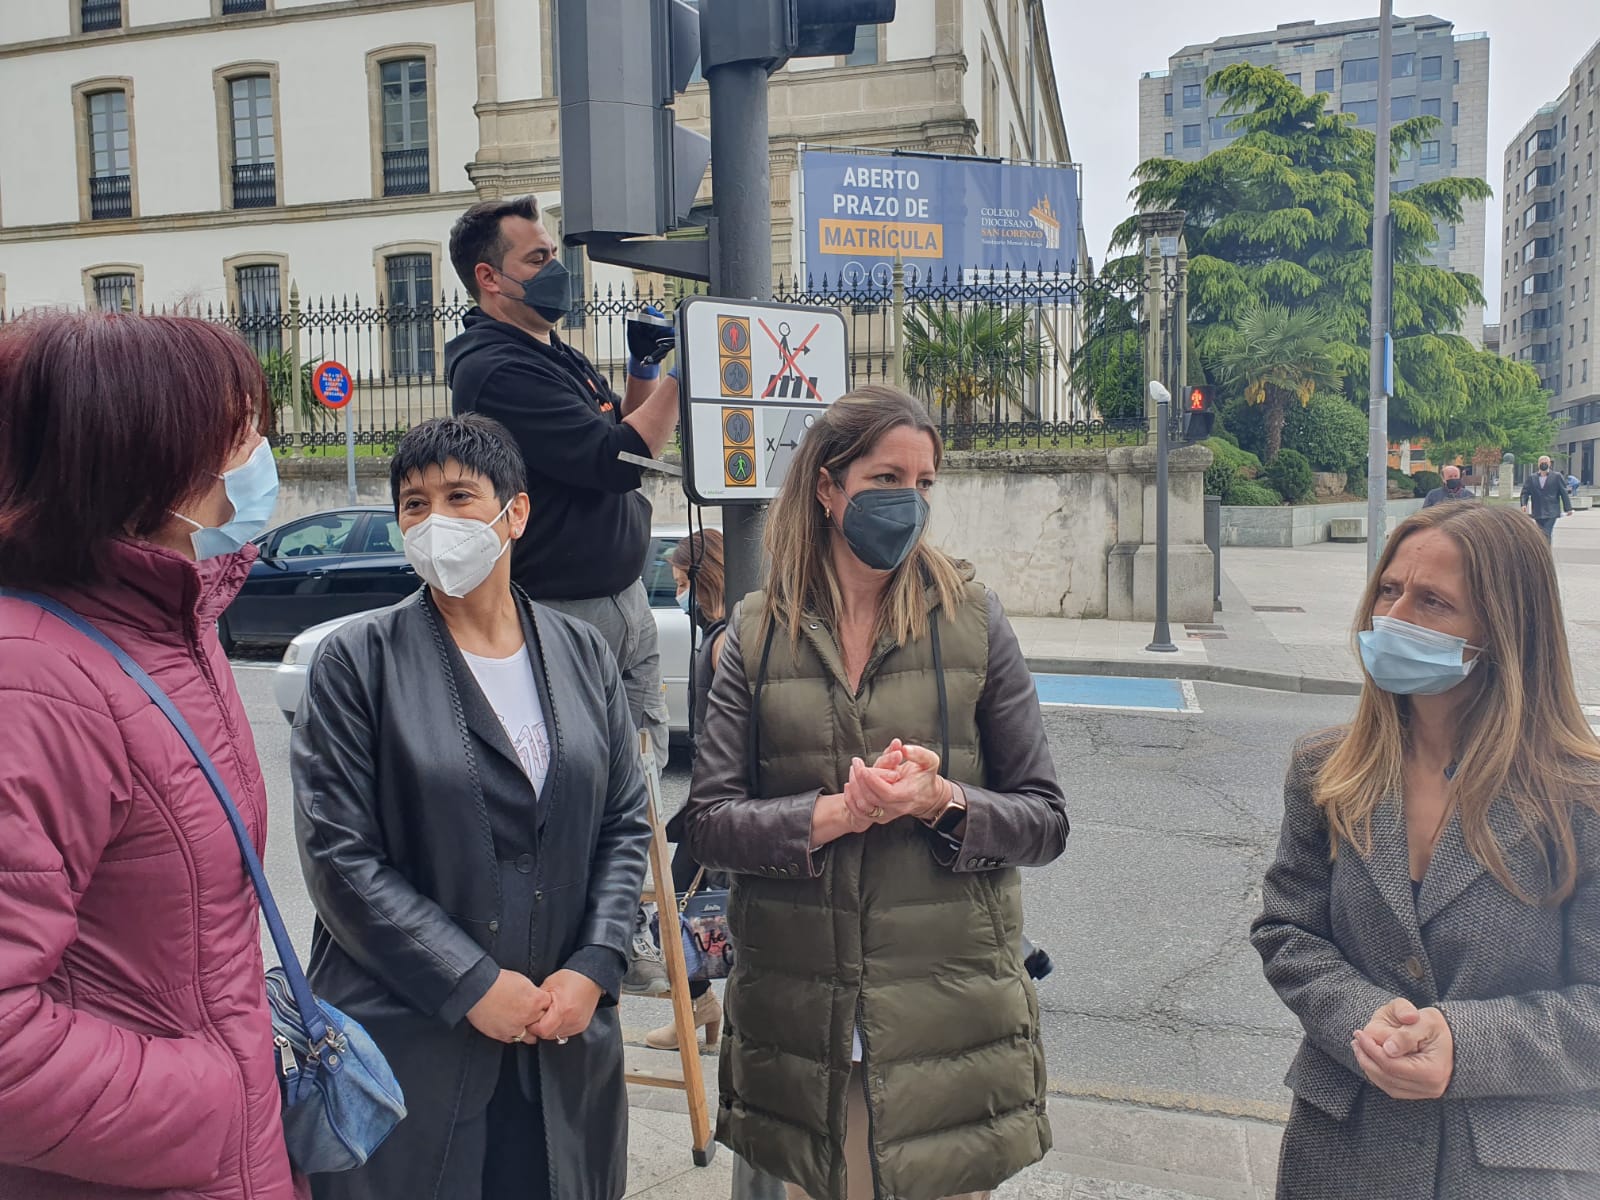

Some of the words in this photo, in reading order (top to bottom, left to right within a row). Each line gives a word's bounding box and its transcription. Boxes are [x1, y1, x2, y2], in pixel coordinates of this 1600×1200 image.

[843, 166, 920, 190] ABERTO
[833, 193, 899, 217] PRAZO
[905, 198, 929, 218] DE
[981, 207, 1020, 218] COLEXIO
[981, 218, 1033, 229] DIOCESANO
[824, 224, 938, 251] MATRÍCULA
[981, 228, 999, 237] SAN
[1002, 229, 1043, 239] LORENZO
